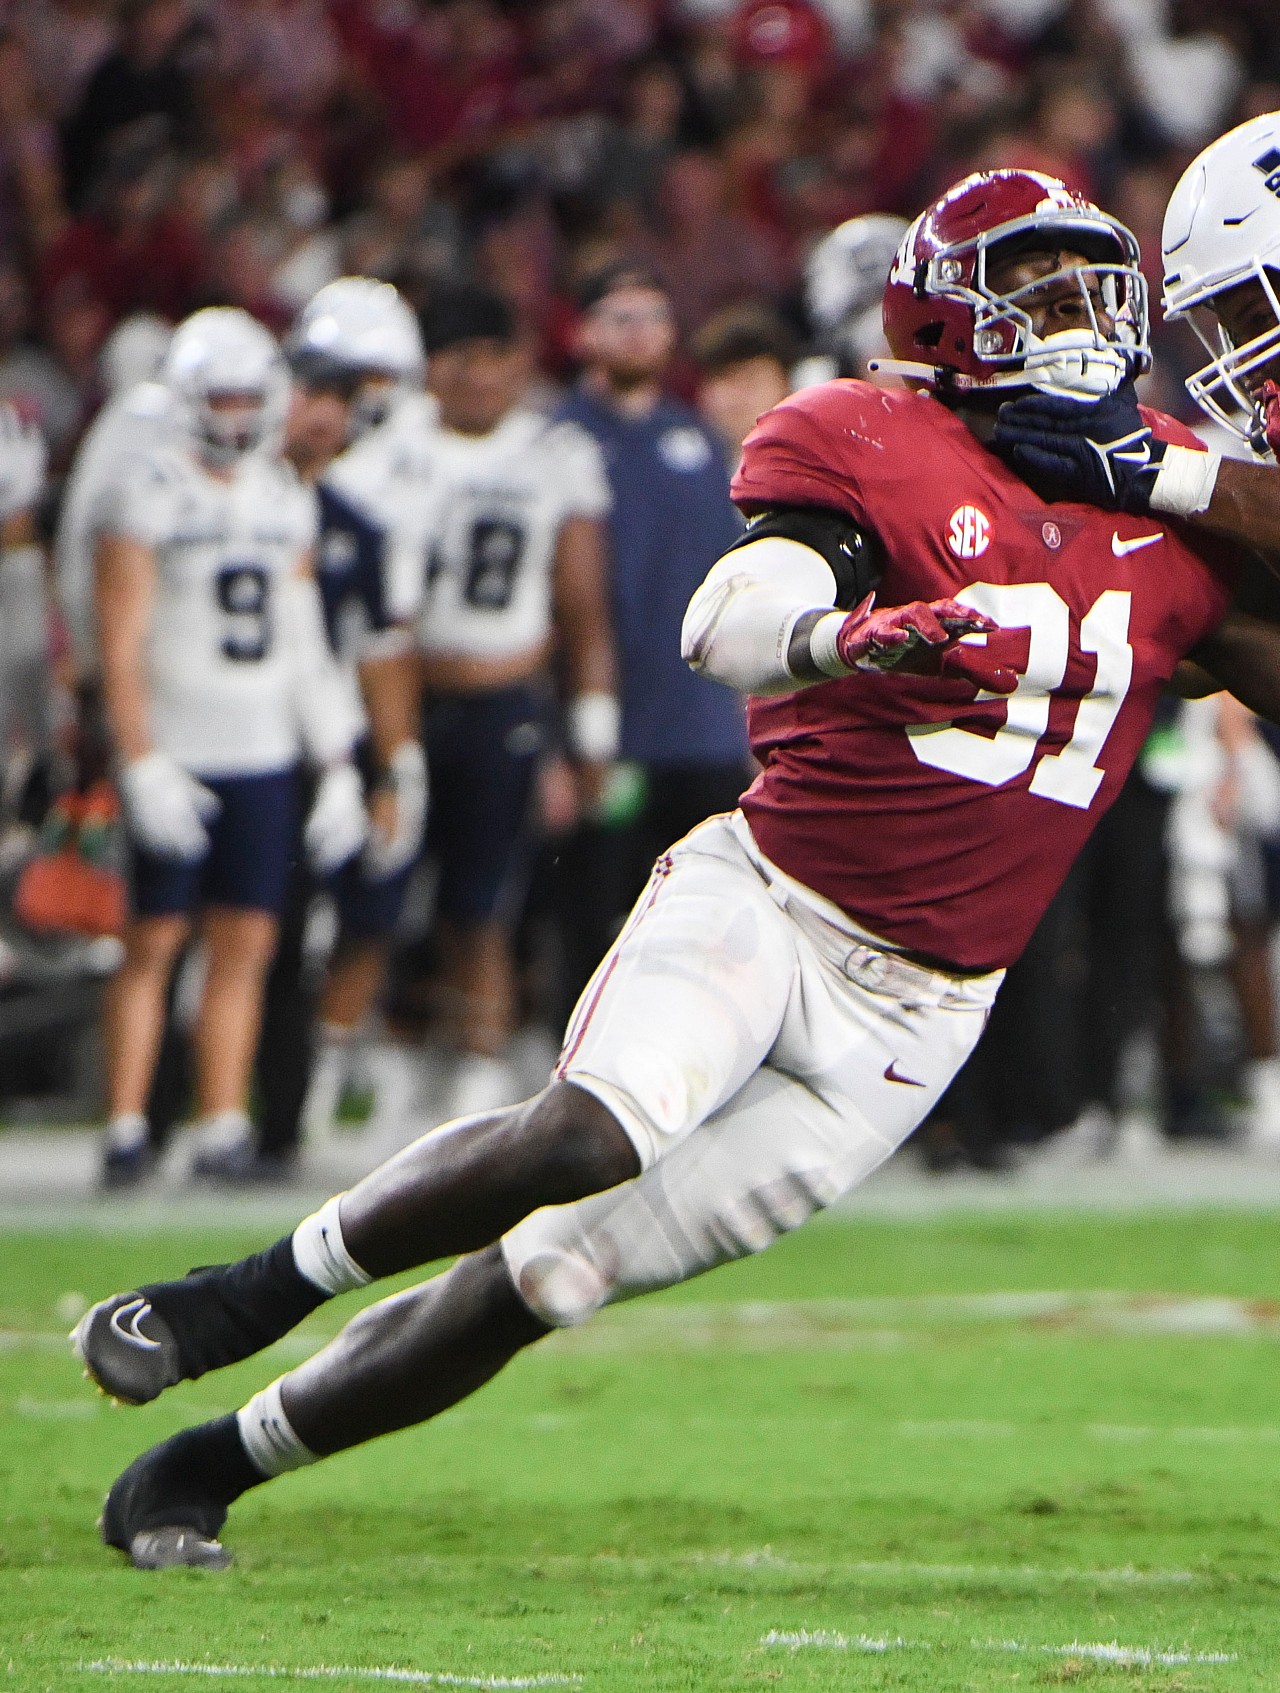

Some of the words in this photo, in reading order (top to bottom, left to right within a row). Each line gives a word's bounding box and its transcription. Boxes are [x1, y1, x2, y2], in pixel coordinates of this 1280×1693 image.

[948, 505, 990, 557] SEC
[215, 562, 269, 663] 9
[905, 581, 1134, 810] 31
